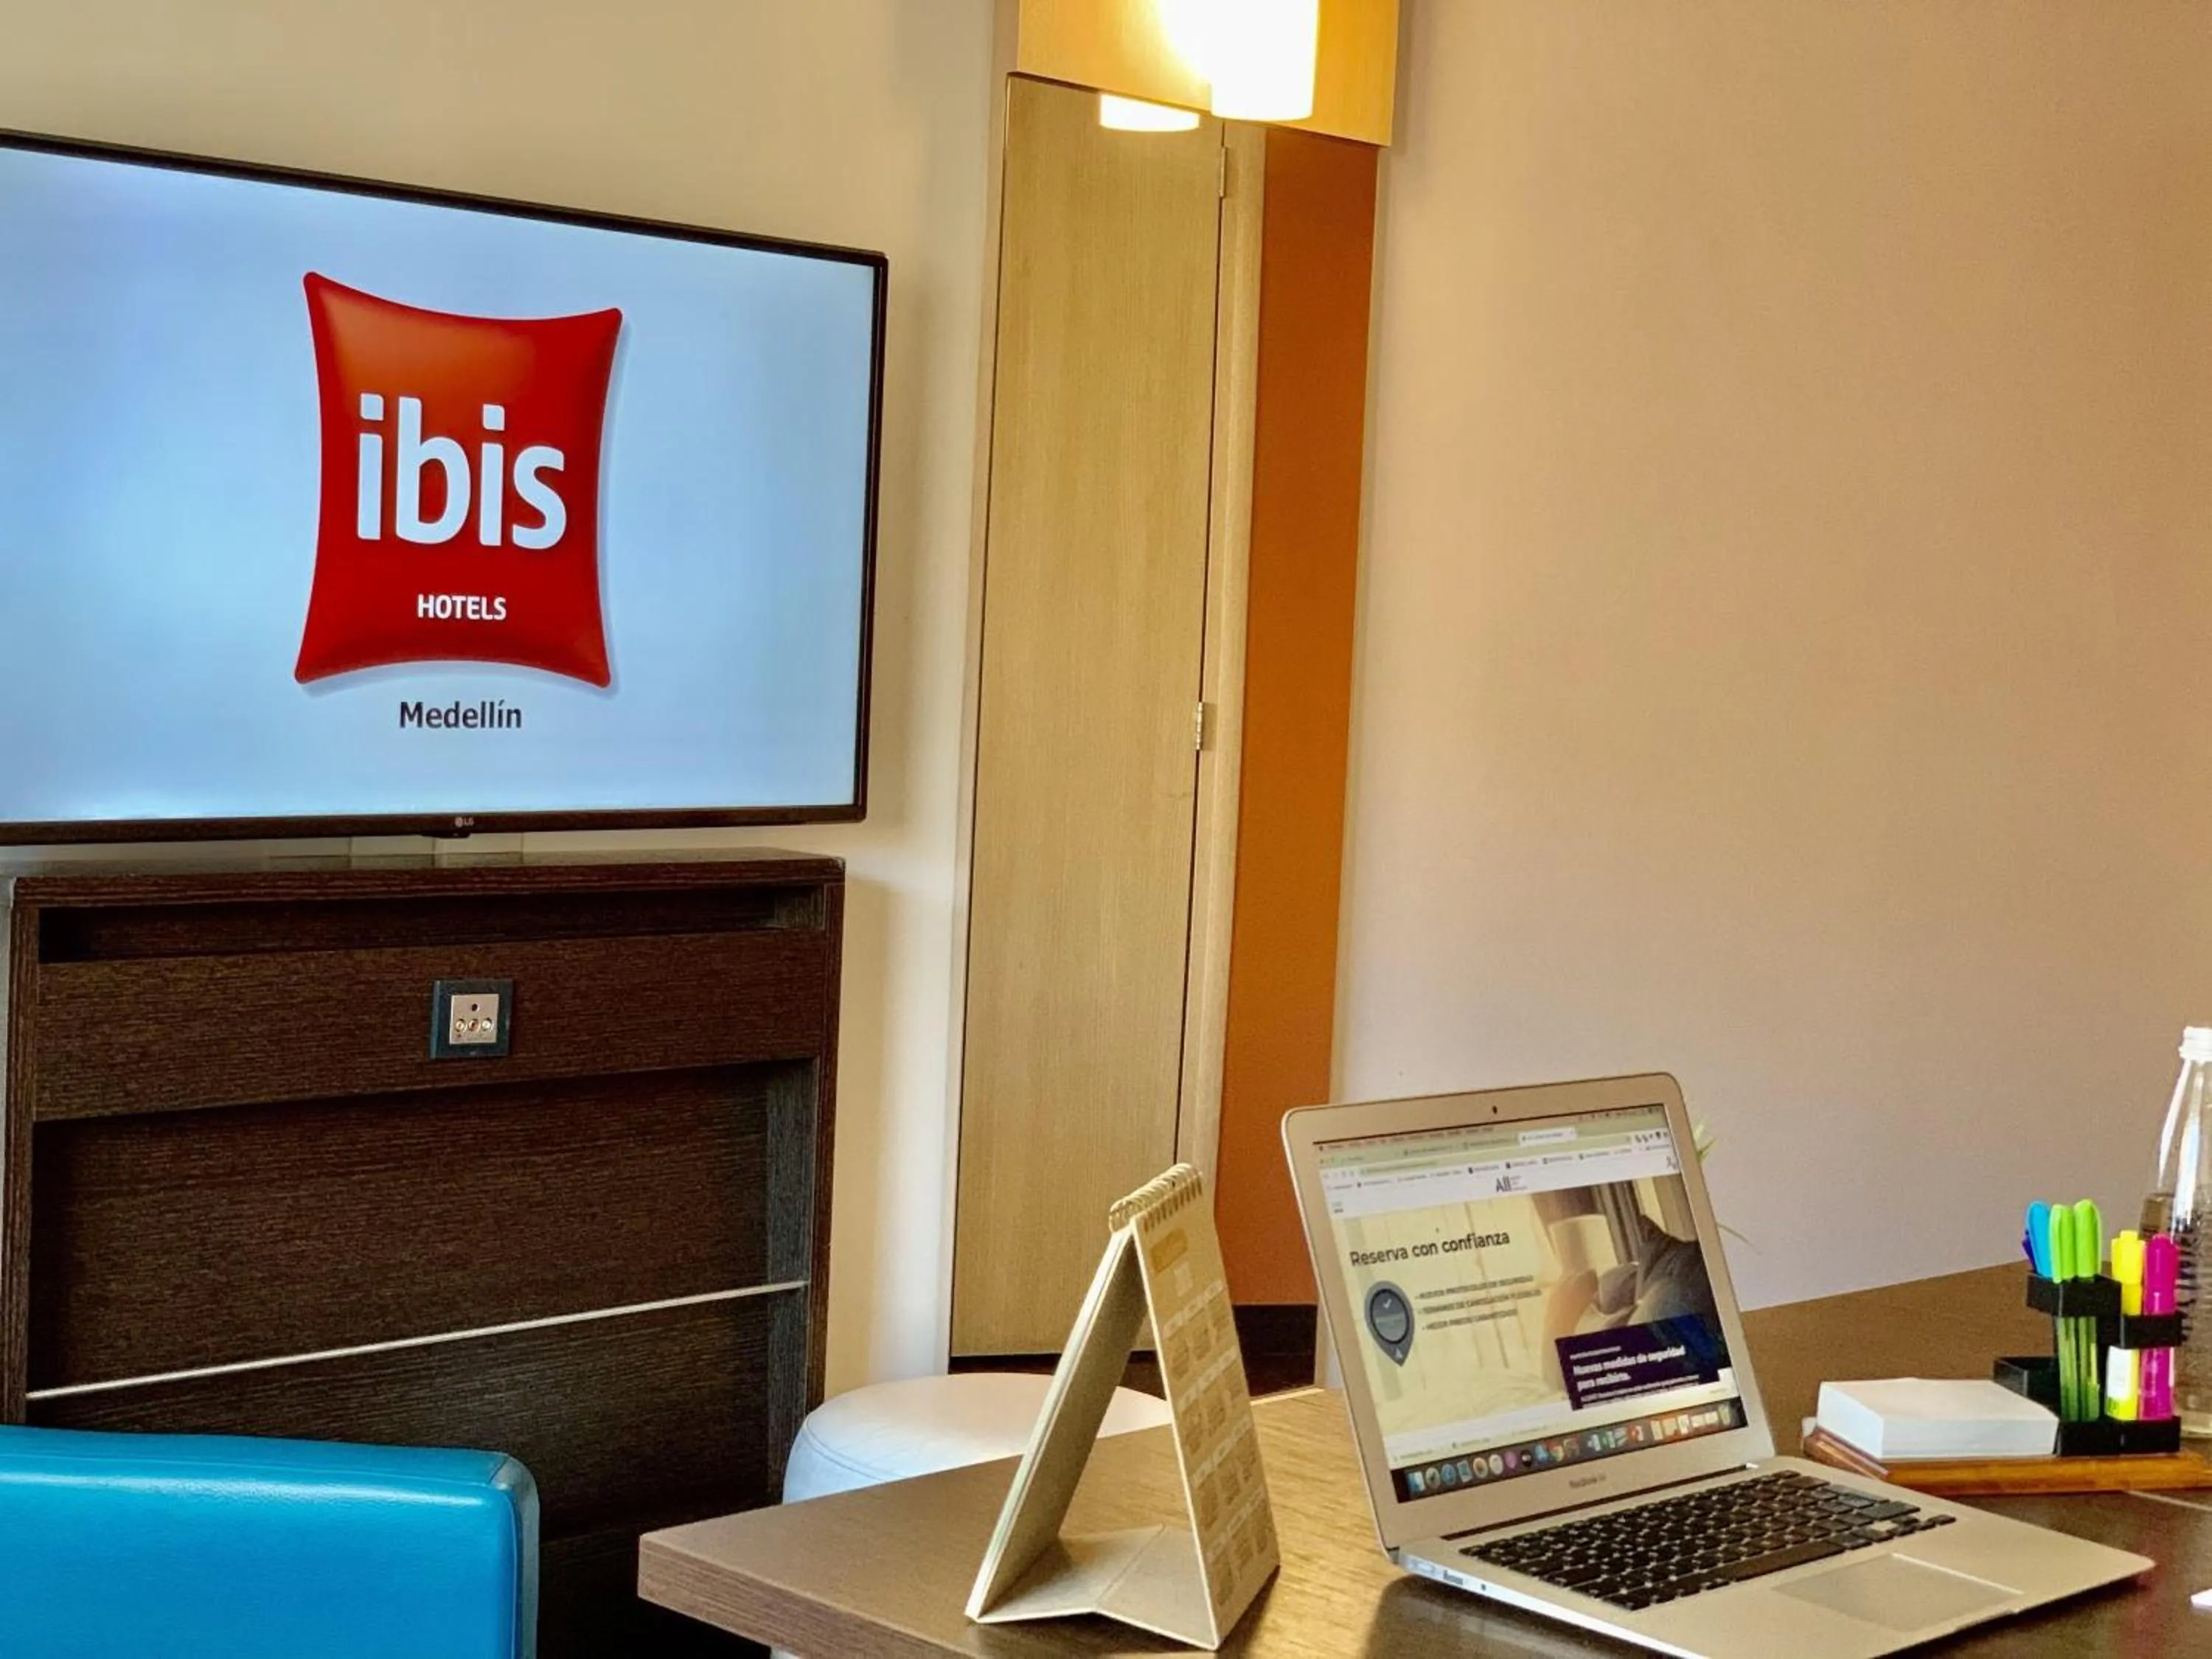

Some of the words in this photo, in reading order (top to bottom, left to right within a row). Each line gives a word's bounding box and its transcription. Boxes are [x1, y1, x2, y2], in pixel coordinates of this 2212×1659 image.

[356, 393, 567, 549] ibis
[417, 594, 507, 621] HOTELS
[400, 699, 522, 729] Medellín
[1349, 1248, 1409, 1266] Reserva
[1412, 1242, 1439, 1257] con
[1442, 1231, 1510, 1253] confianza
